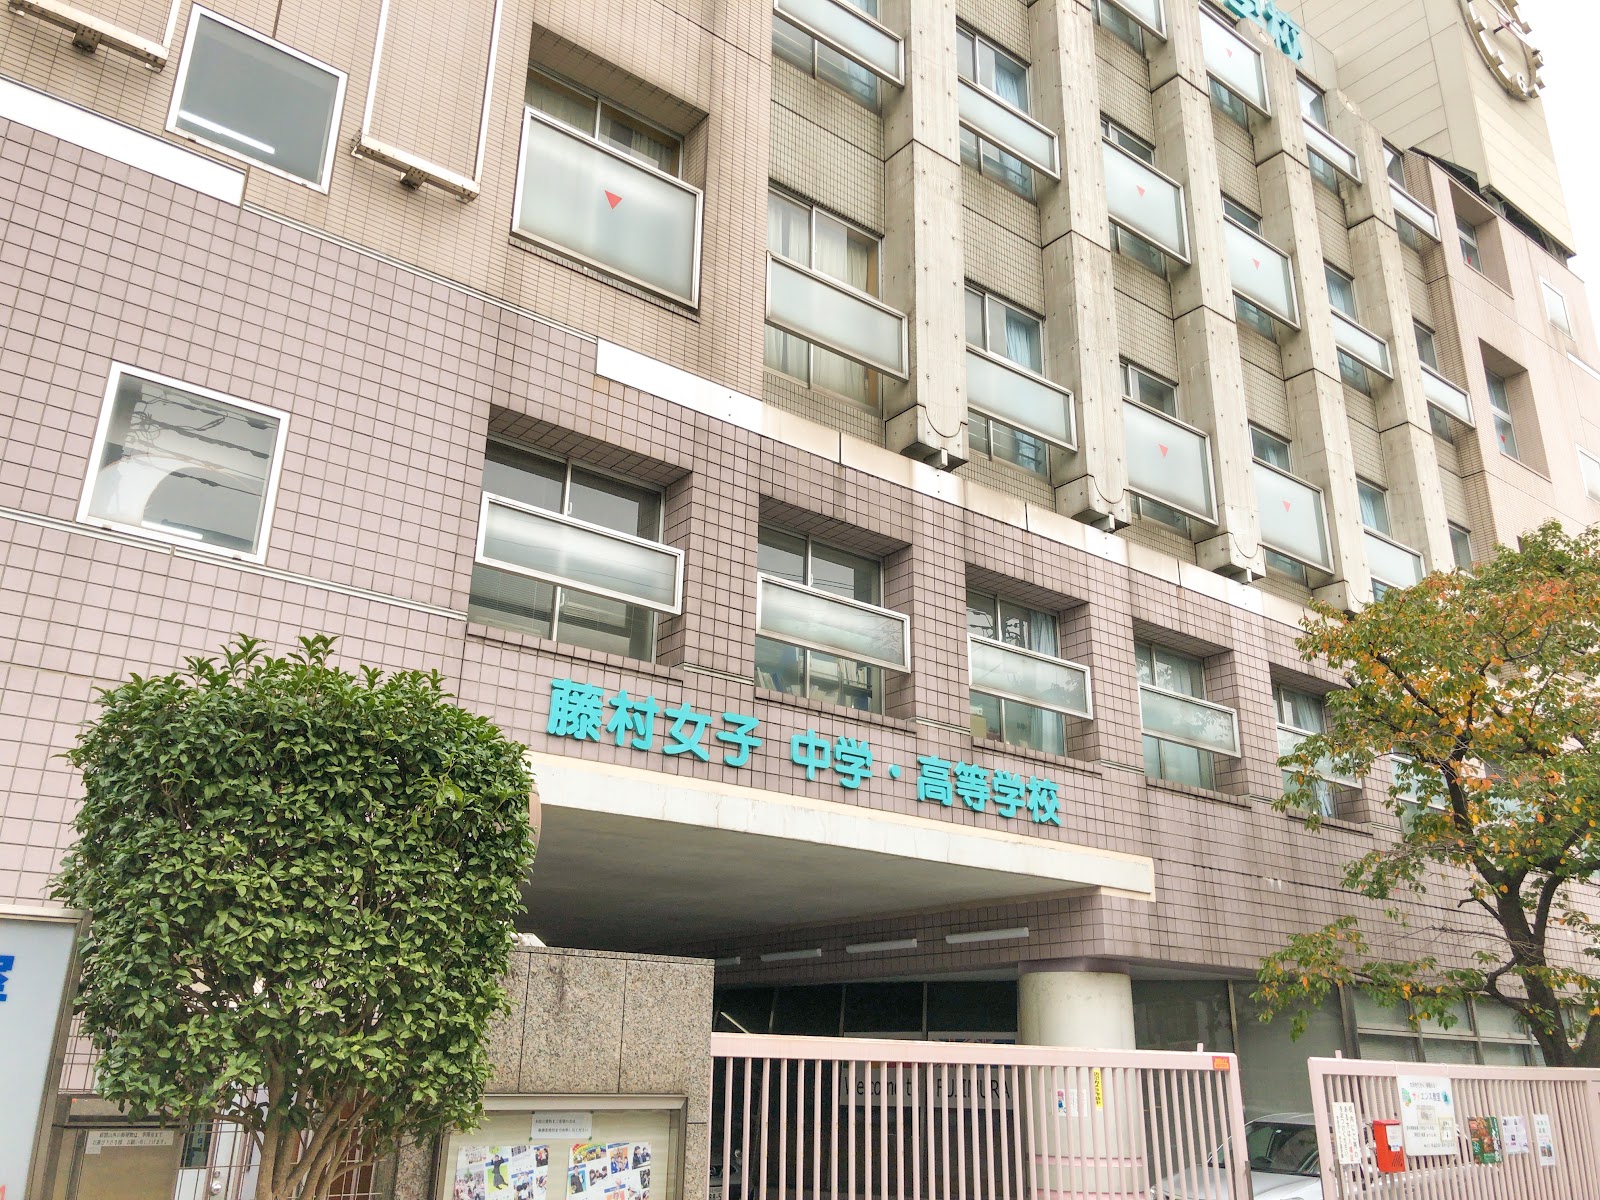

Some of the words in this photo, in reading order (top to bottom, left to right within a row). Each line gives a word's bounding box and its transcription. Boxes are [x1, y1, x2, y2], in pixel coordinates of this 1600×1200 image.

[547, 678, 762, 768] 藤村女子
[790, 729, 1062, 827] 中学・高等学校
[845, 1077, 903, 1096] ecom
[936, 1078, 1011, 1099] FUIMURA
